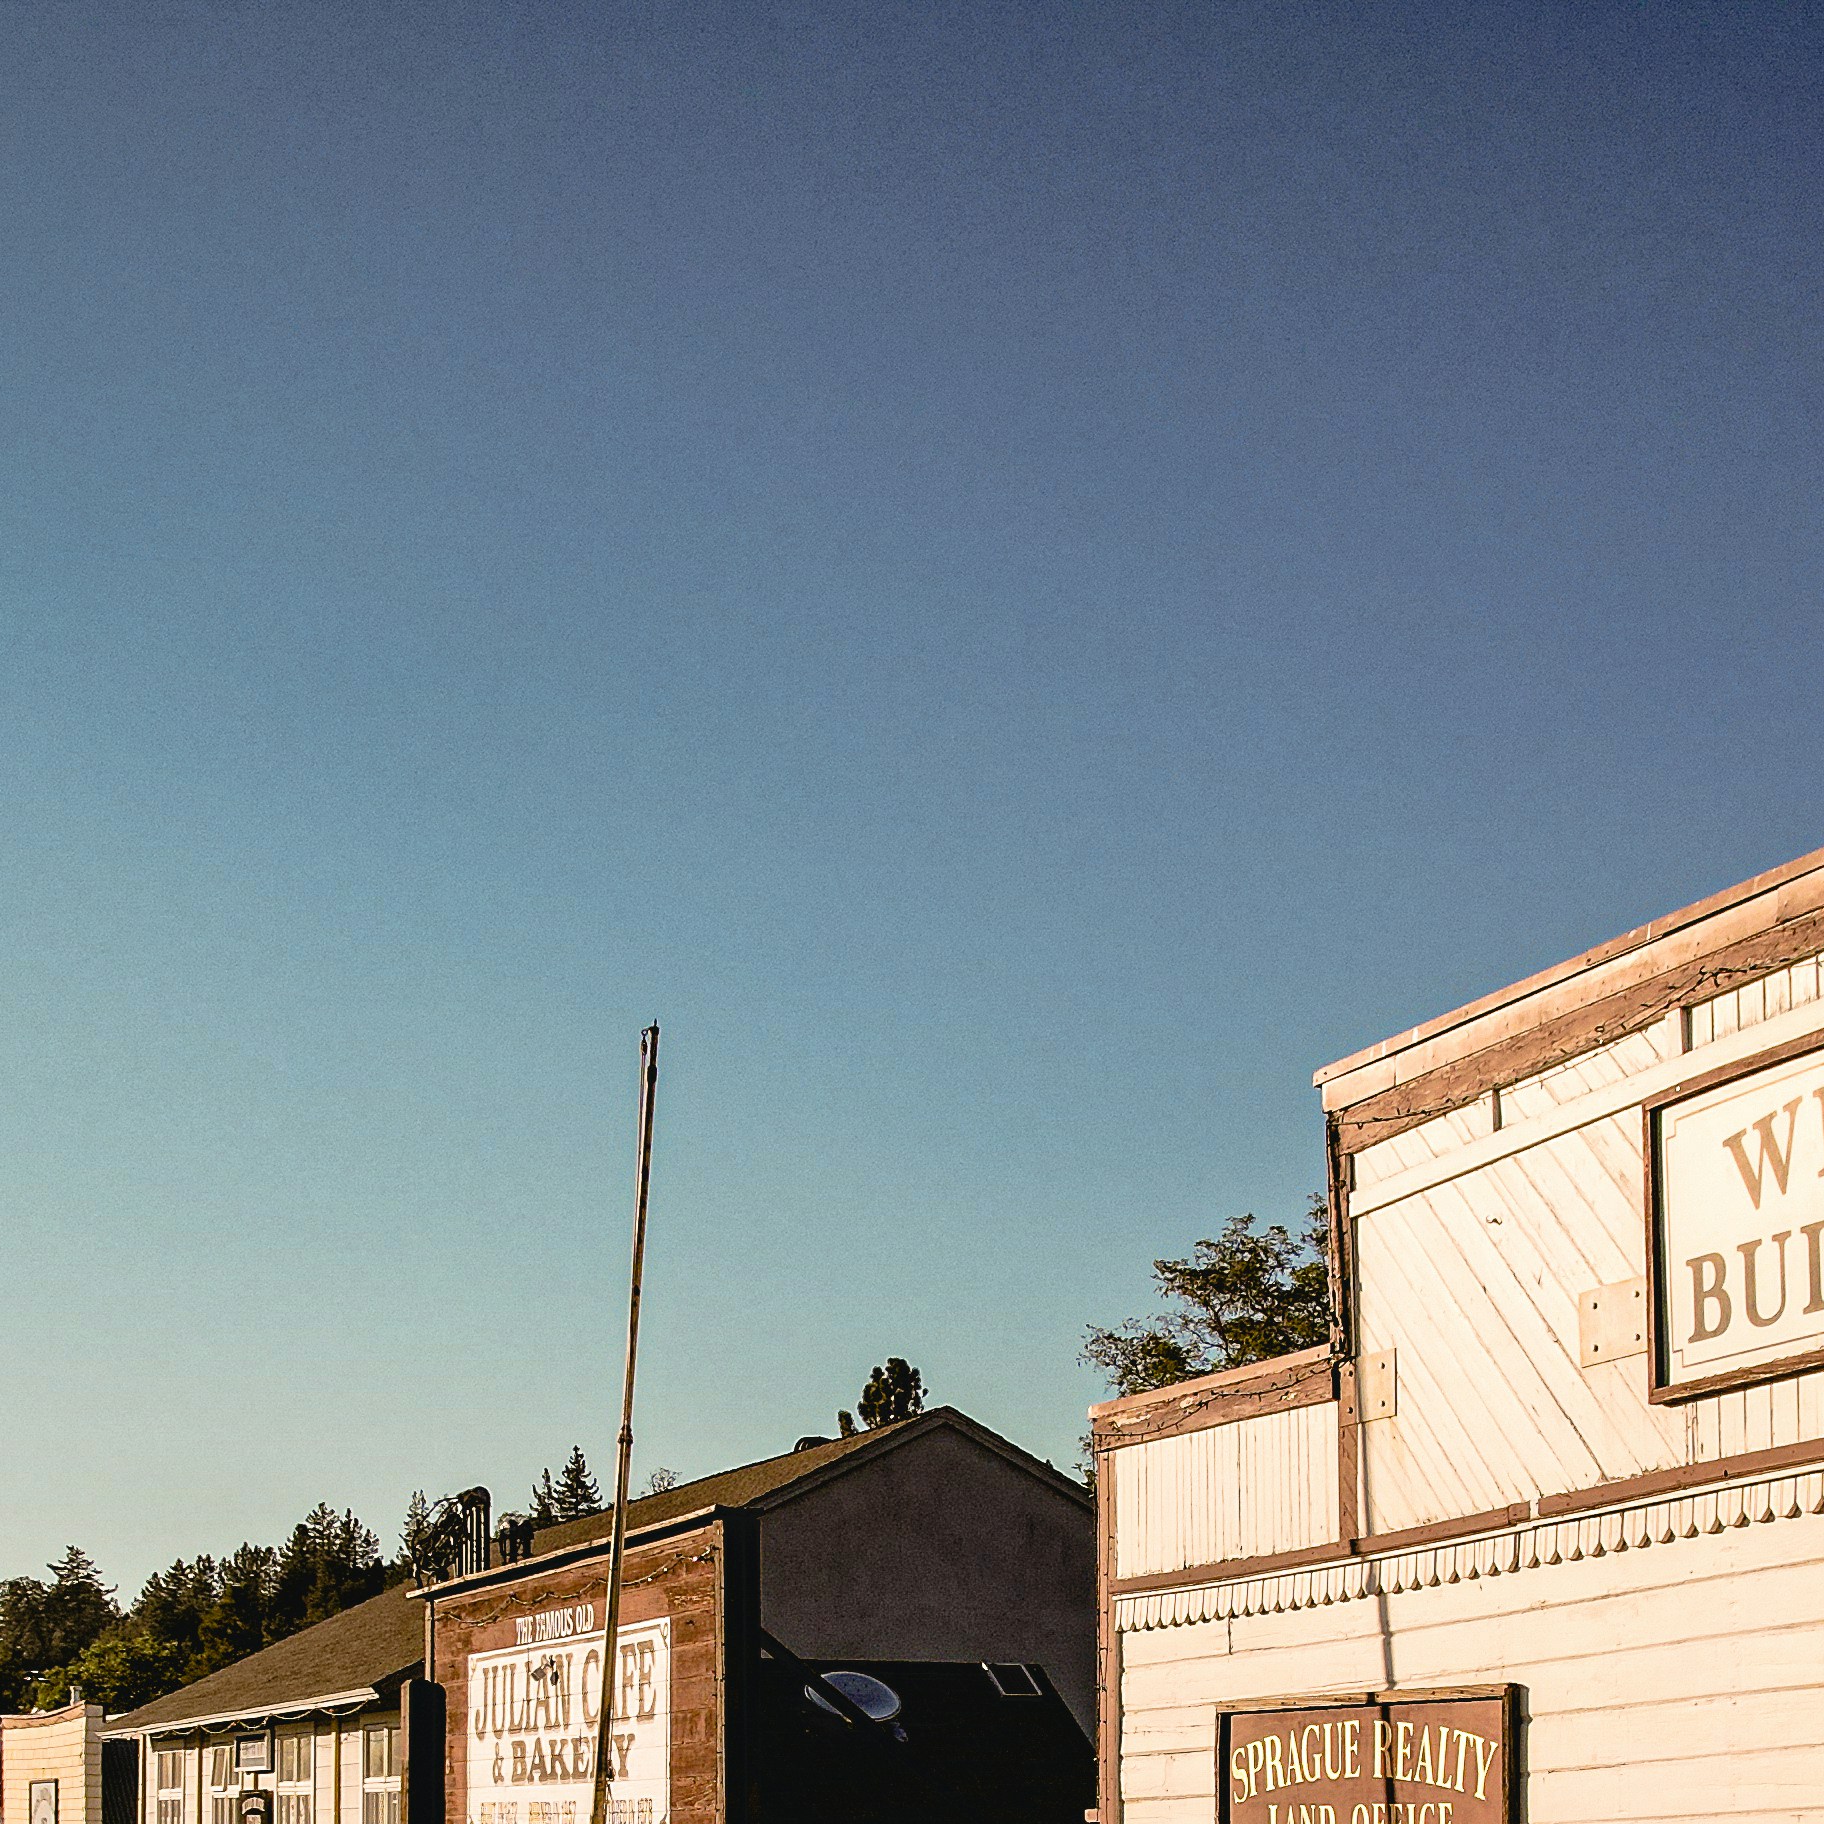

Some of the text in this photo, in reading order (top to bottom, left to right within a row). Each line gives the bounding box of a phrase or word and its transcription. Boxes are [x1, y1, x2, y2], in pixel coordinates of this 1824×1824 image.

[516, 1603, 595, 1646] THE FAMOUS OLD
[475, 1639, 657, 1741] JULIAN CFE
[492, 1741, 505, 1785] &
[1230, 1719, 1499, 1805] SPRAGUE REALTY
